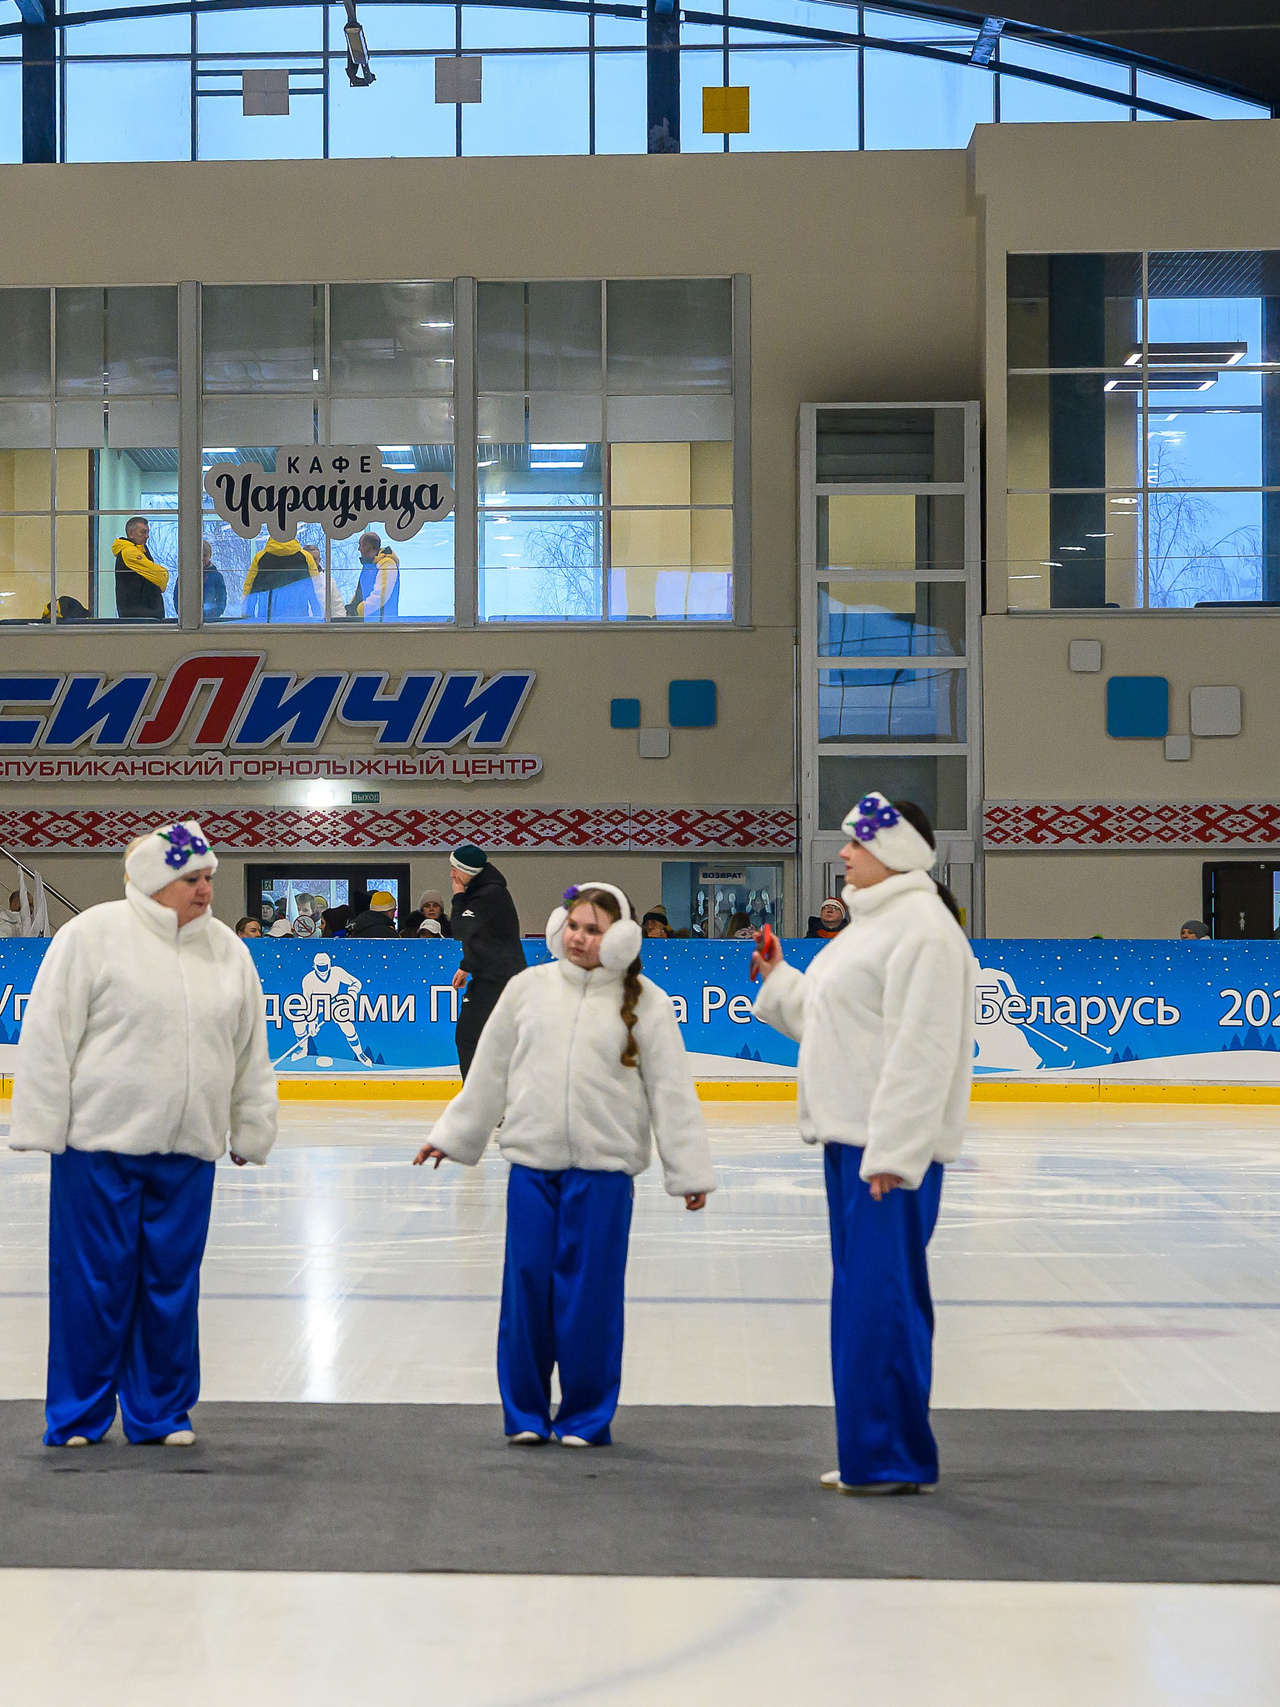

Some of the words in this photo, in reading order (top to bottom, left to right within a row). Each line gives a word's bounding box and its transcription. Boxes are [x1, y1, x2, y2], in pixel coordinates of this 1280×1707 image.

[287, 455, 372, 474] КАФЕ
[215, 473, 445, 532] Чараўніца
[229, 756, 444, 776] ГОРНОЛЫЖНЫЙ
[452, 759, 538, 778] ЦЕНТР
[974, 985, 1181, 1036] Беларусь
